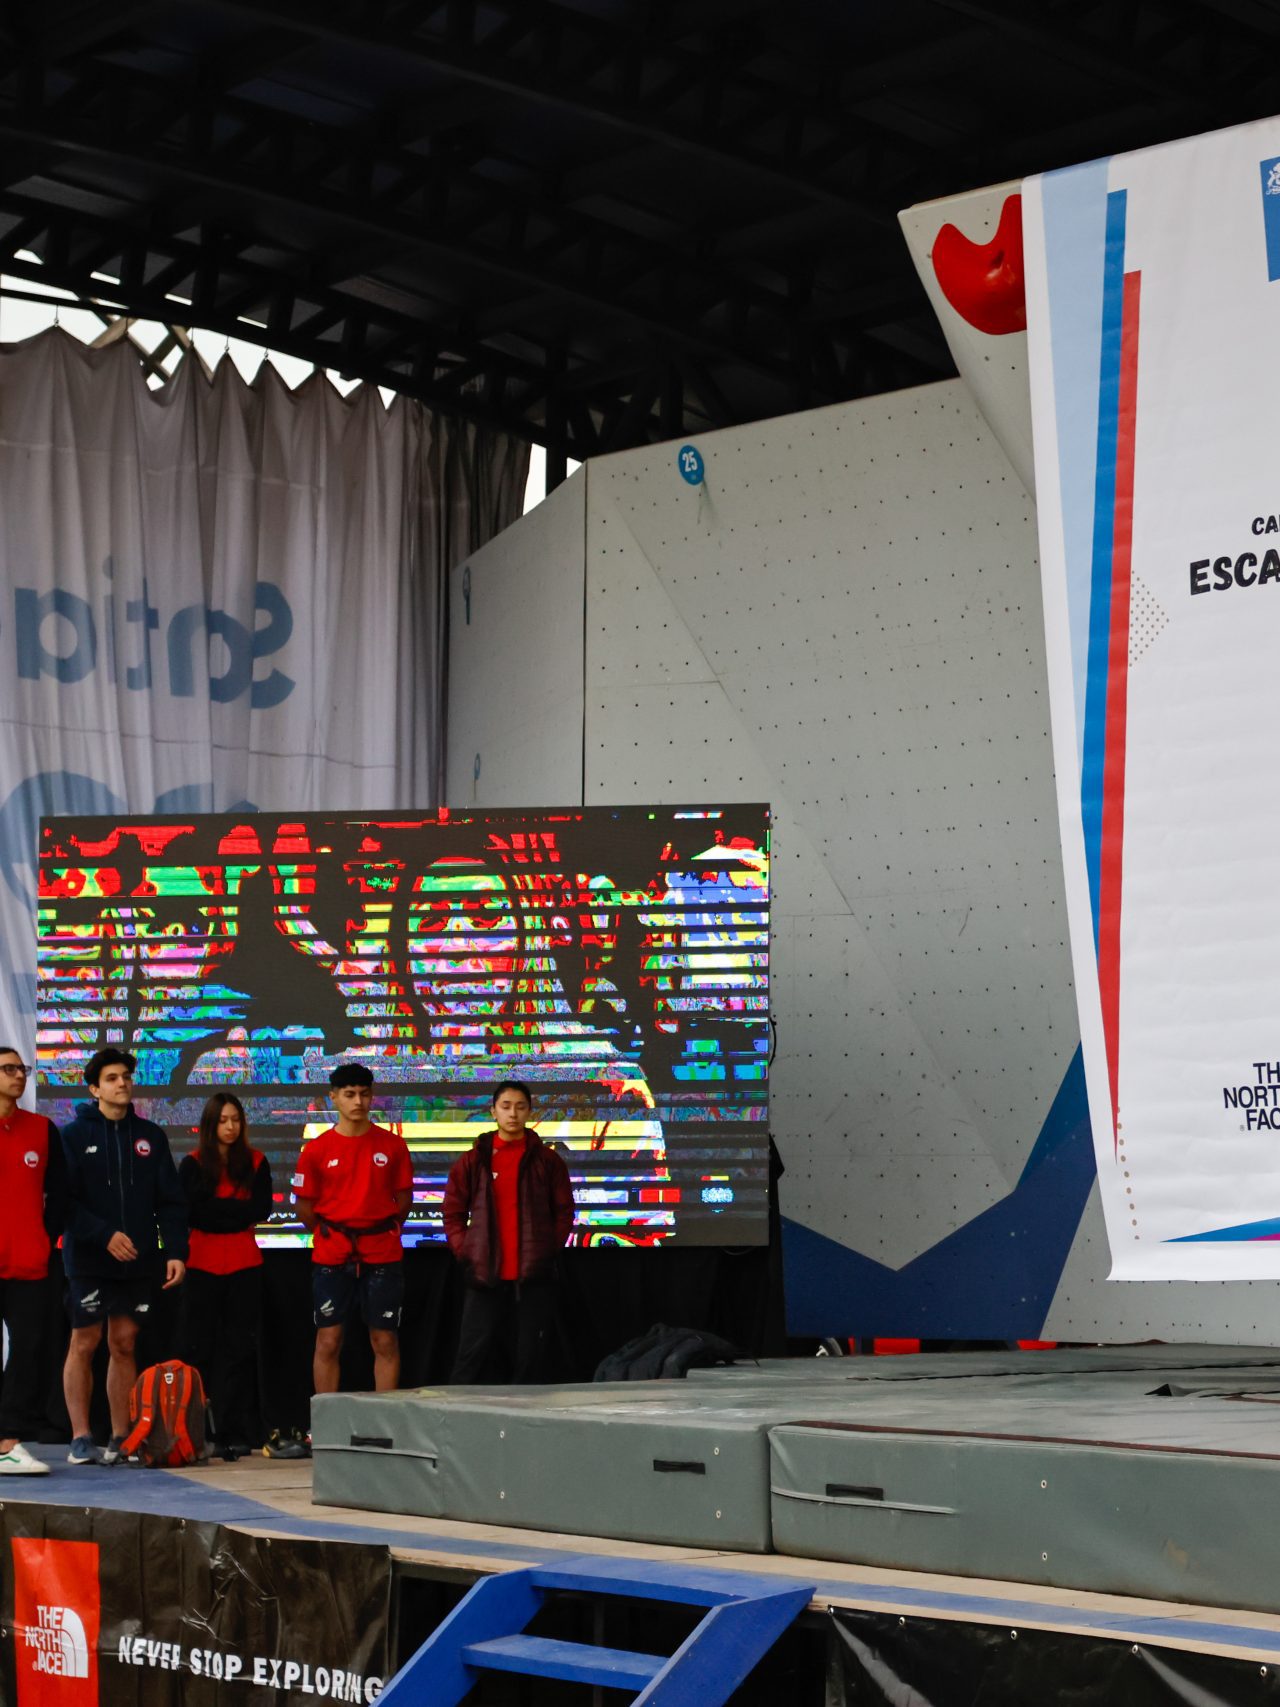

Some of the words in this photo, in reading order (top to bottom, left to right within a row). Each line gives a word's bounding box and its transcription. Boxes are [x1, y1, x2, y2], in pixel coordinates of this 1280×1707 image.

[682, 451, 698, 472] 25
[37, 1605, 63, 1629] THE
[190, 1648, 243, 1682] STOP
[253, 1657, 385, 1706] EXPLORING
